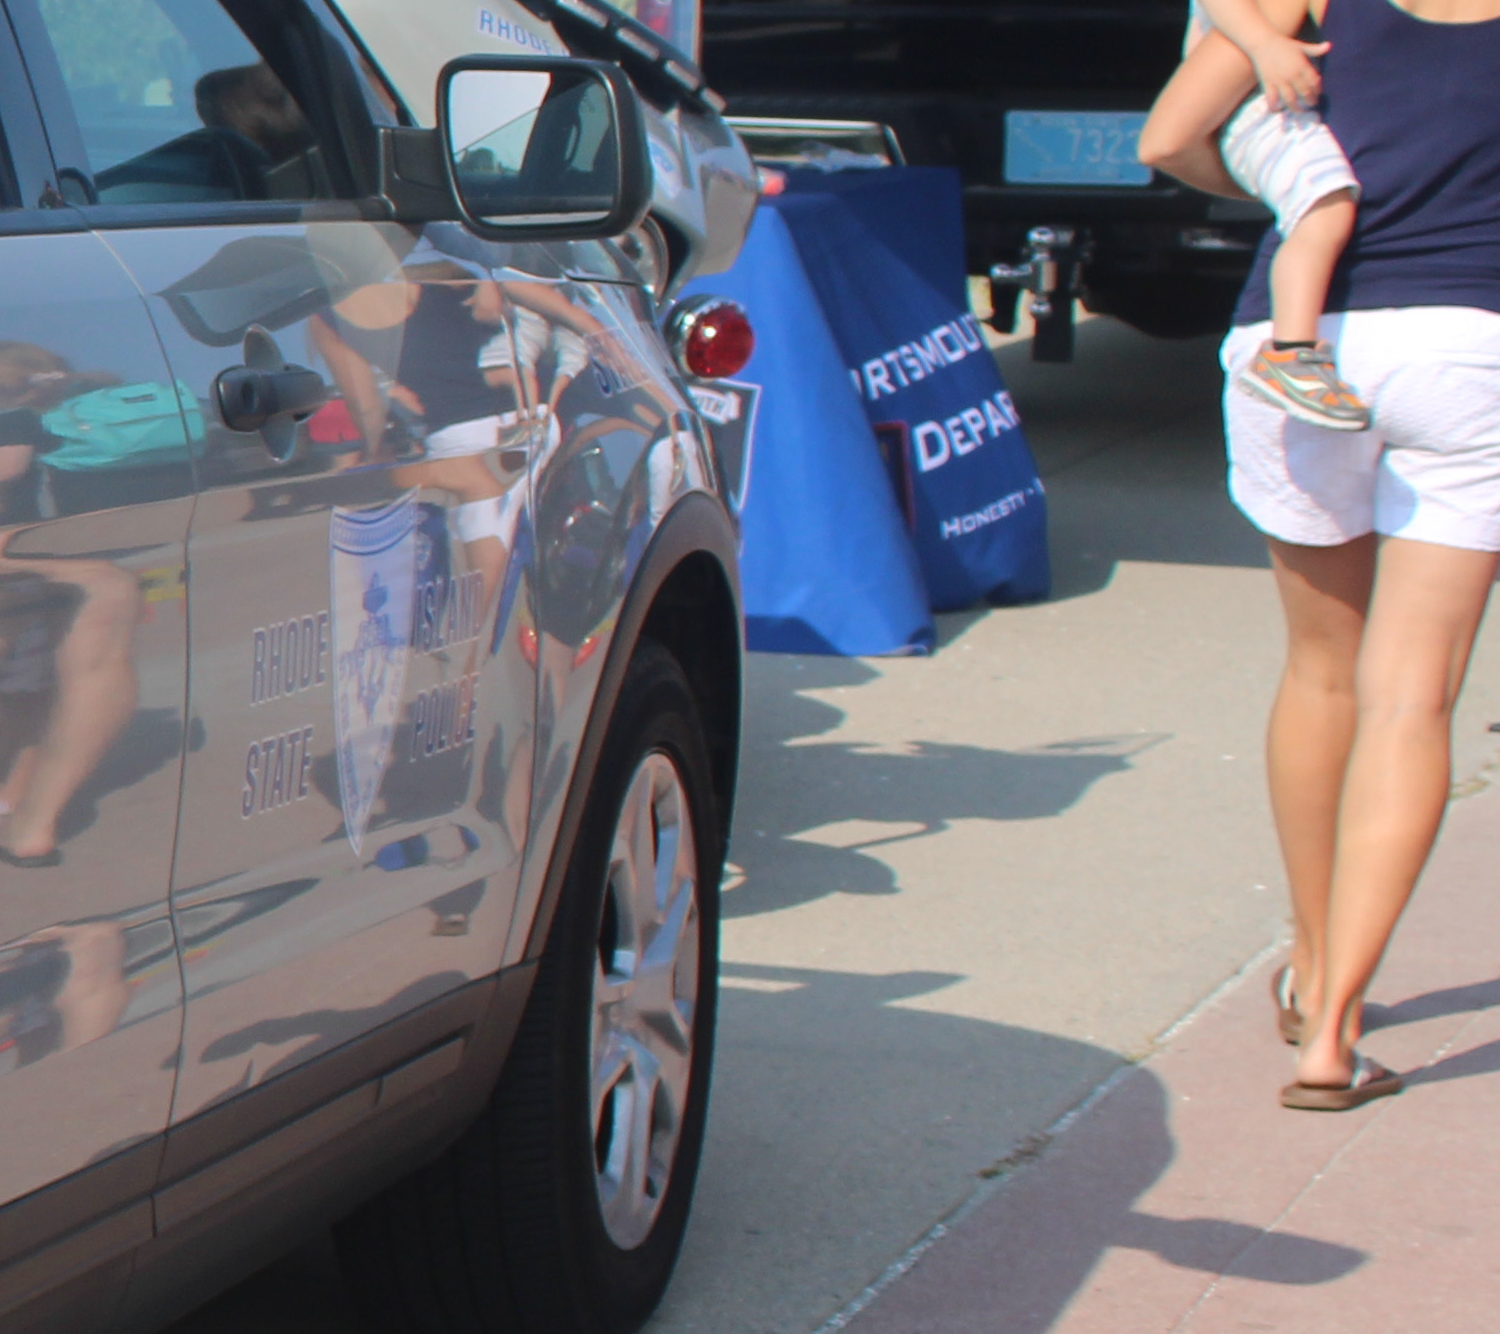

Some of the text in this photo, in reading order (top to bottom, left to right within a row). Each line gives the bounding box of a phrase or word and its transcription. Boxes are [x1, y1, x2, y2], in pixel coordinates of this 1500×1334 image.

[250, 569, 485, 707] RHODE ISLAND
[241, 671, 482, 820] STATE POLICE
